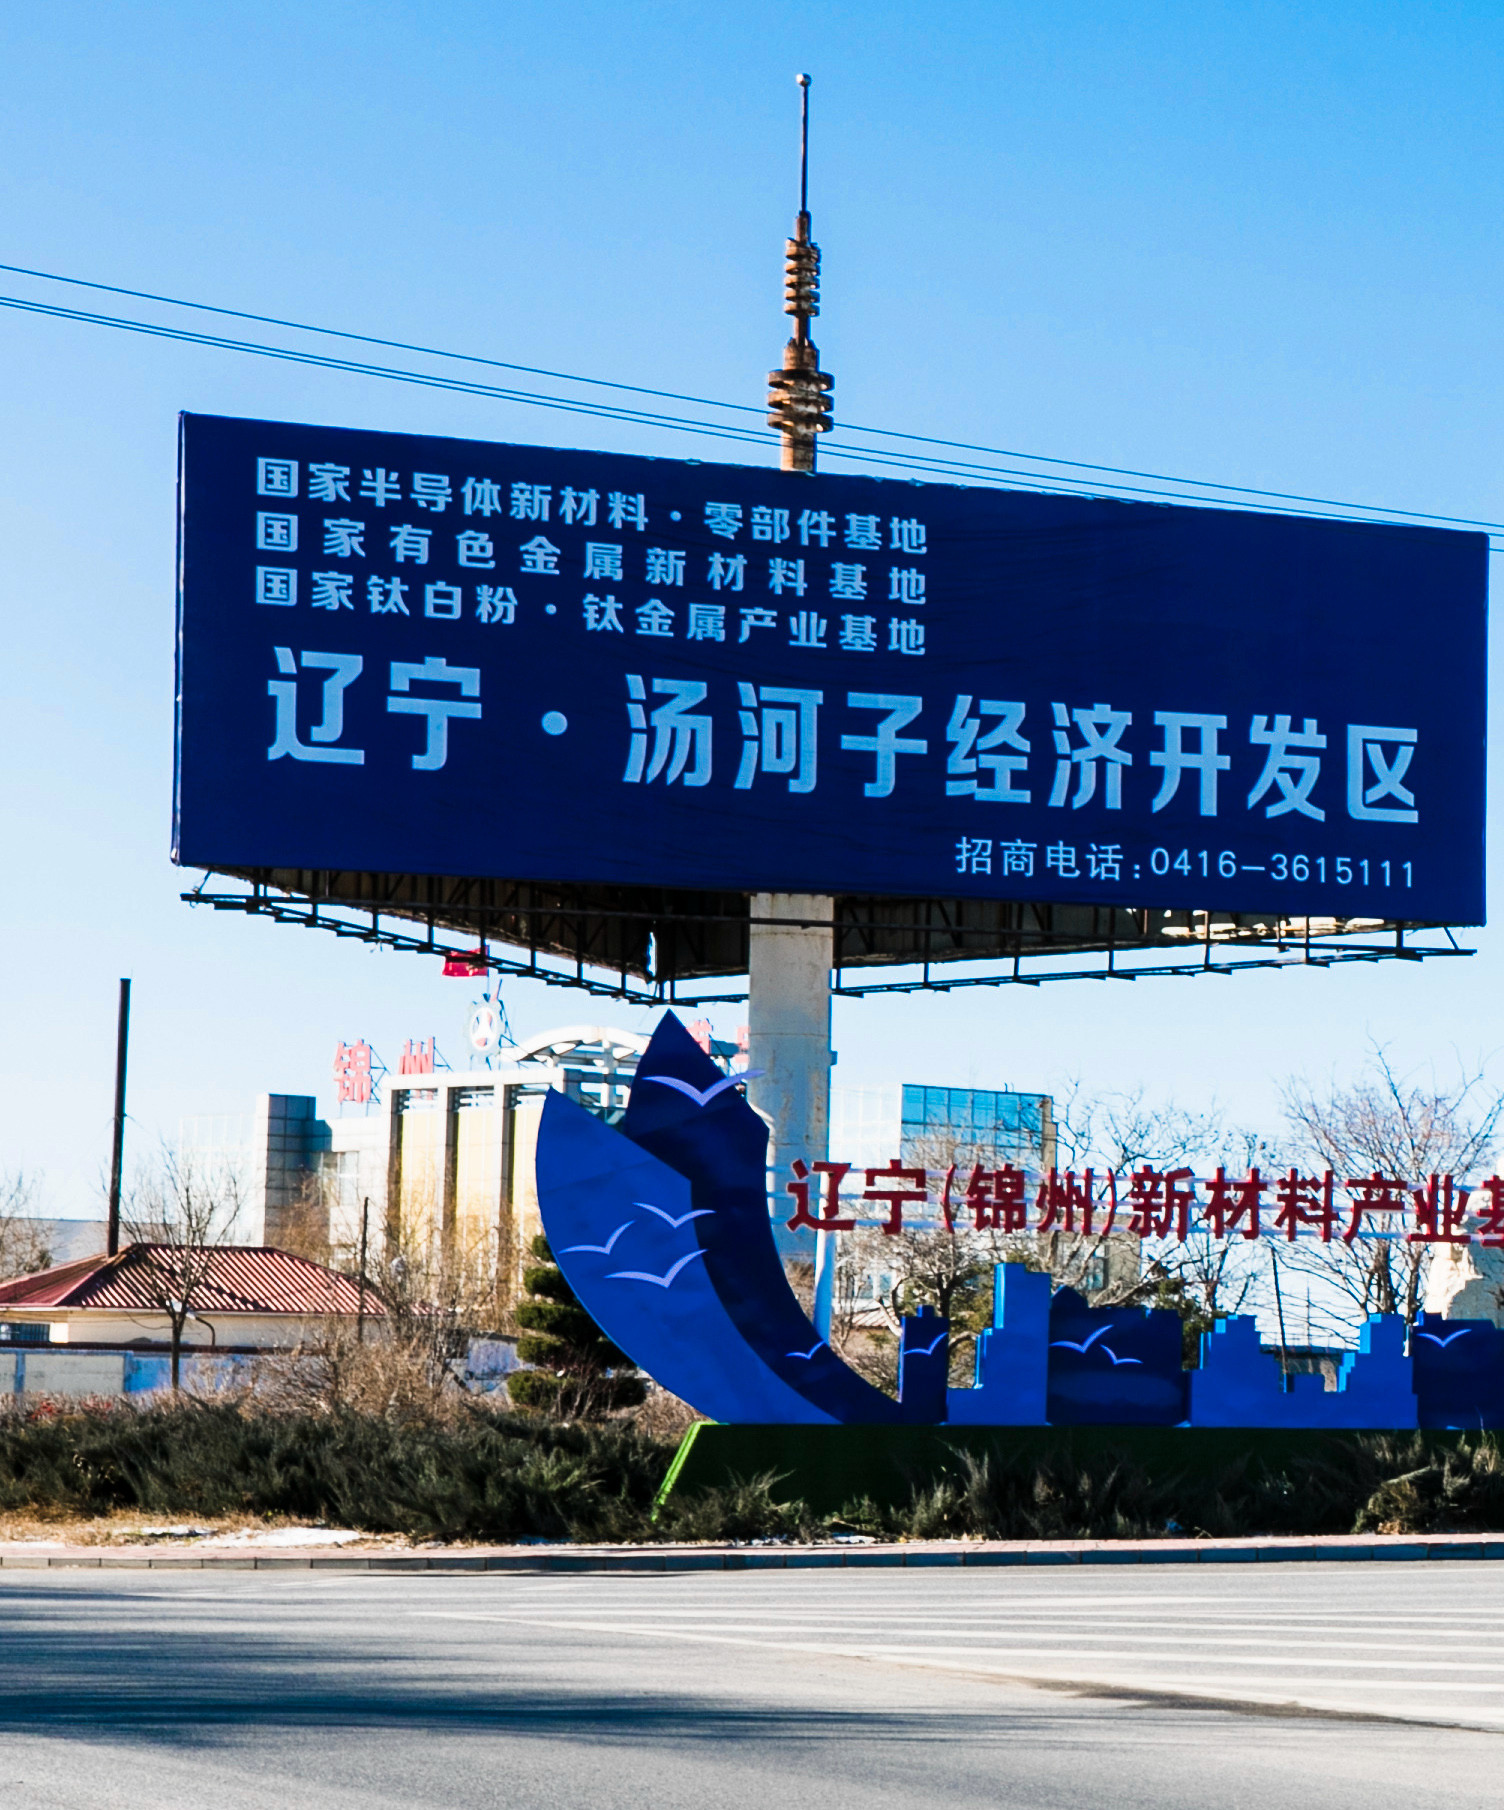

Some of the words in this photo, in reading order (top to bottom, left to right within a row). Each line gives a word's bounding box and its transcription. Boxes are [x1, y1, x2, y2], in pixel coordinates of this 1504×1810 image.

[256, 456, 928, 555] 国家半导体新材料·零部件基地
[256, 512, 927, 605] 国家有色金属新材料基地
[256, 565, 926, 656] 国家钛白粉·钛金属产业基地
